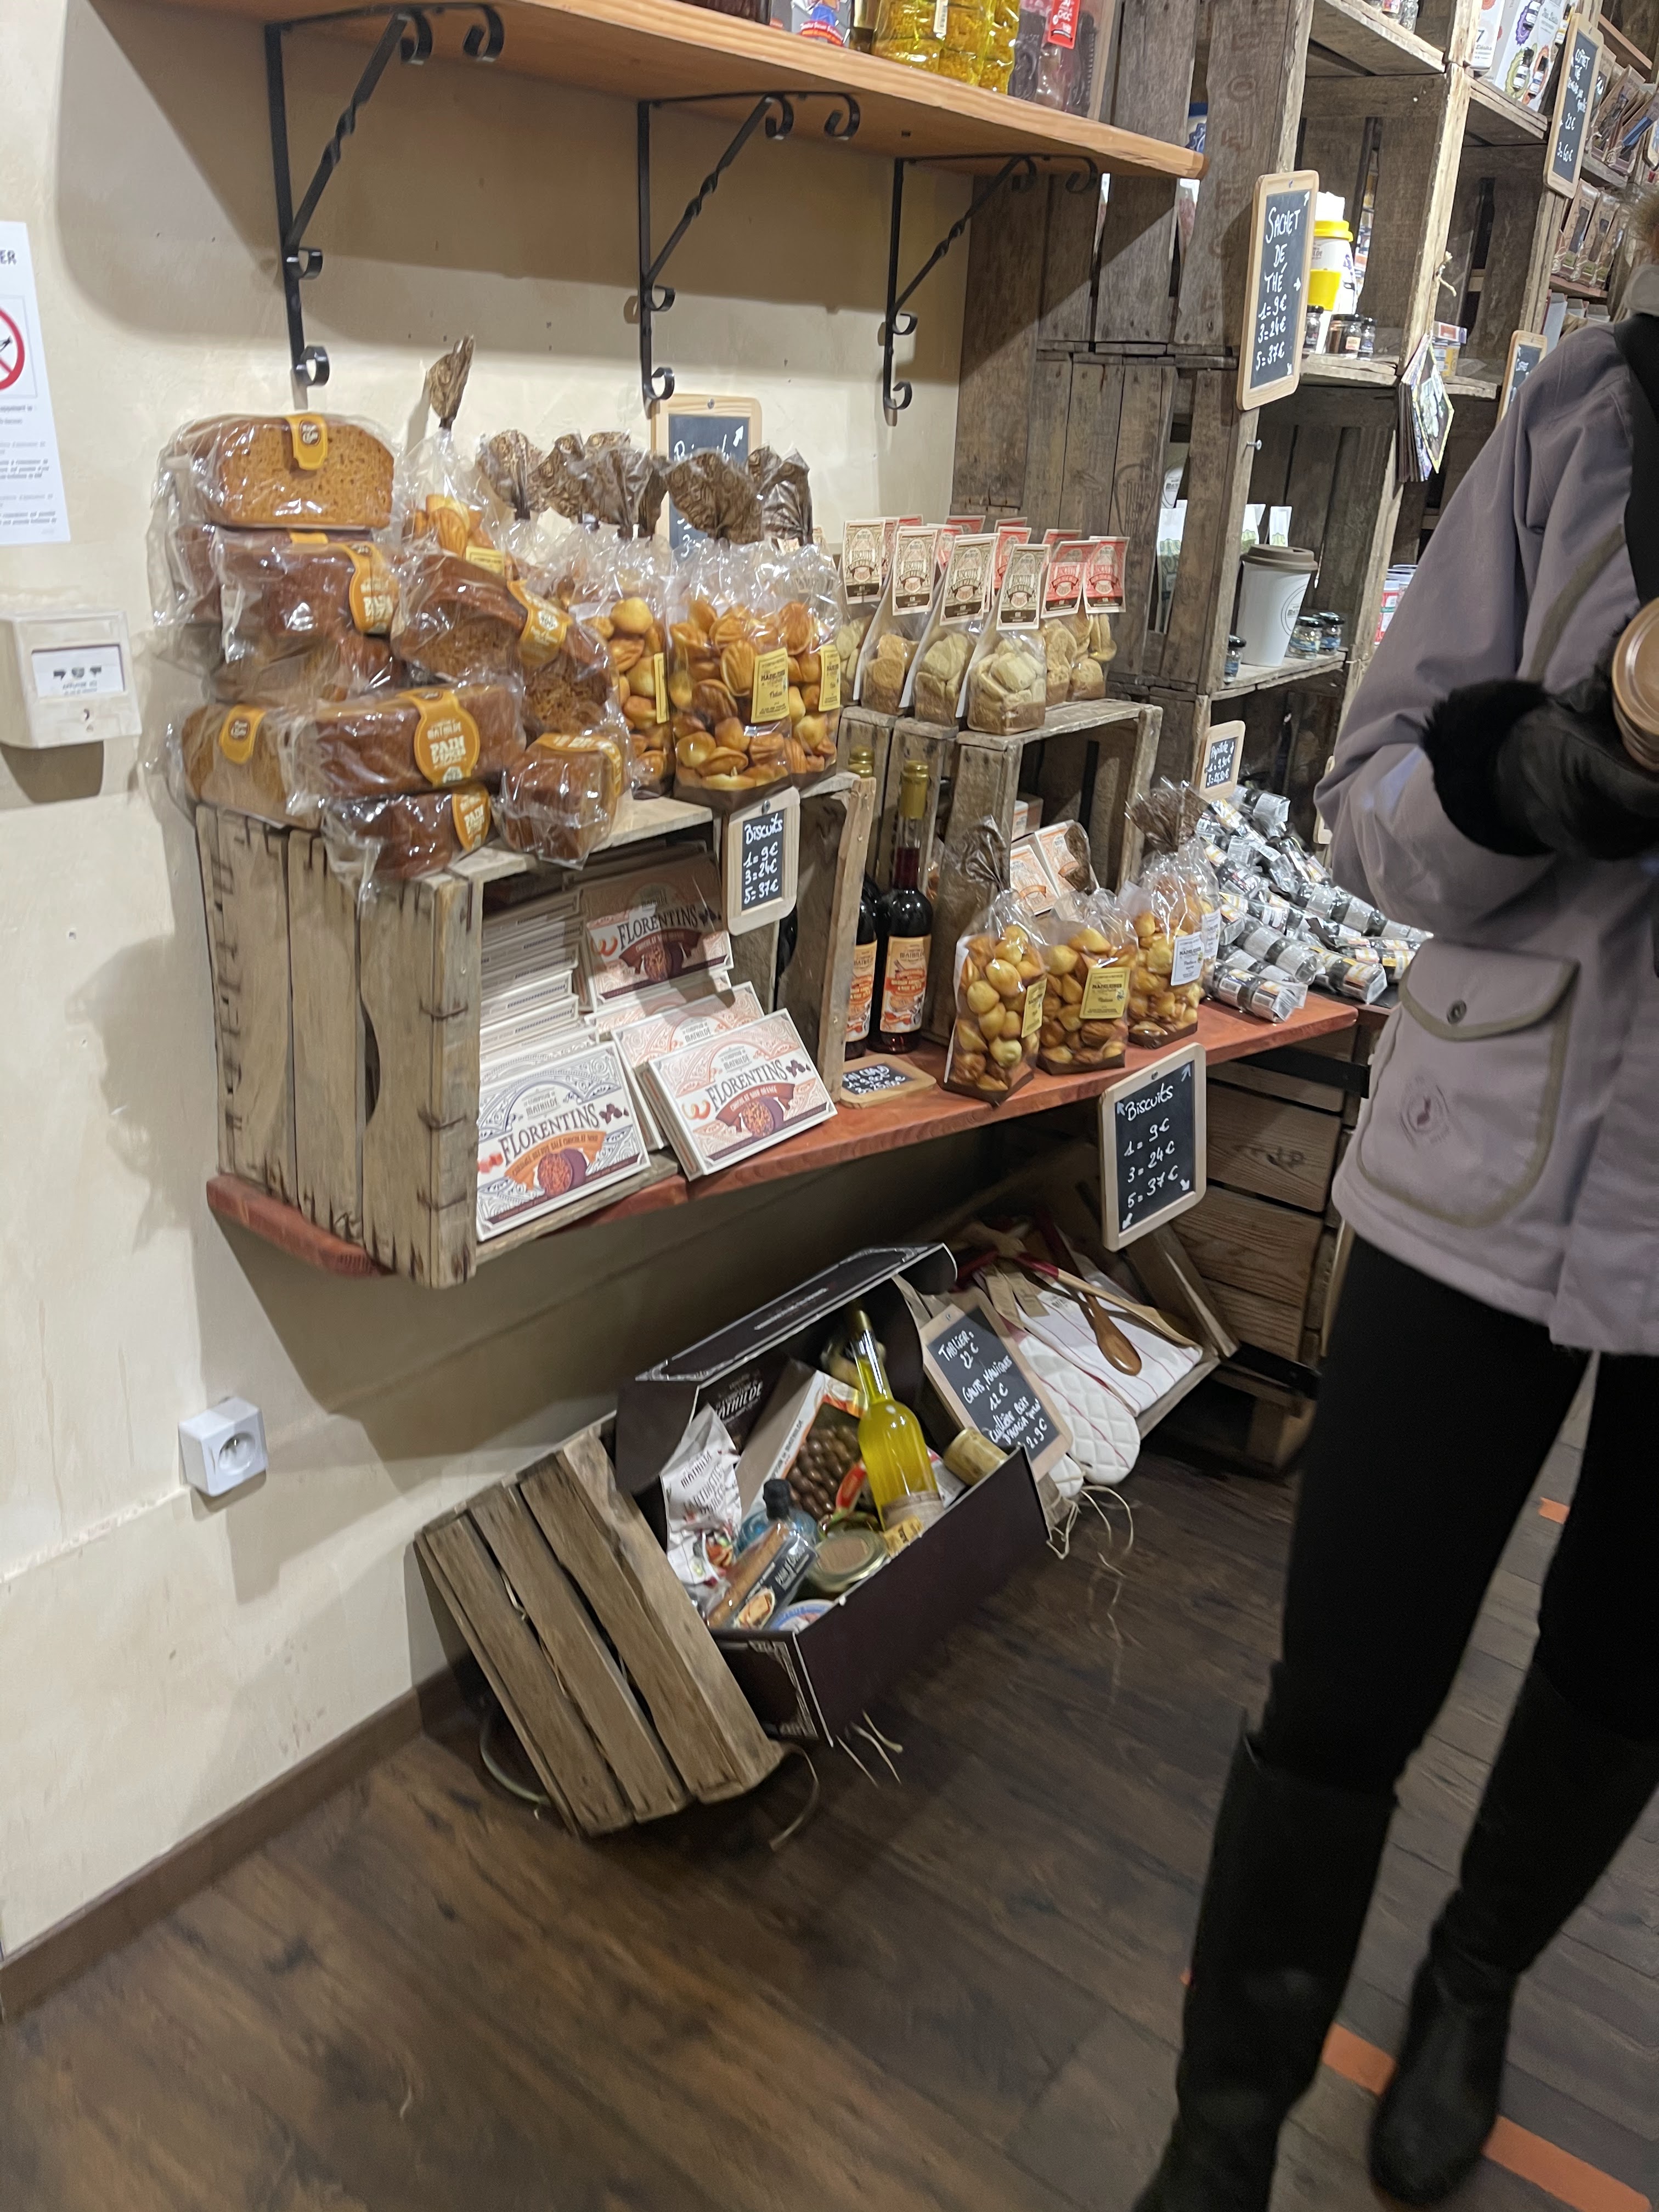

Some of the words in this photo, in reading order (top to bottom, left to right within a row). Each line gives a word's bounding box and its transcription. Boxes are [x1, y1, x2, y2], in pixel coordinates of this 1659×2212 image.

[1266, 206, 1301, 244] SACHET
[1273, 244, 1288, 268] DE
[1264, 262, 1288, 293] THÉ
[744, 812, 783, 845] Biscuits
[617, 906, 698, 951] FLORENTINS
[724, 1054, 751, 1069] MATHILDE
[705, 1059, 788, 1112] FLORENTINS
[1125, 1082, 1173, 1121] Biscuits
[526, 1097, 558, 1116] MATHILDE
[498, 1103, 600, 1166] FLORENTINS
